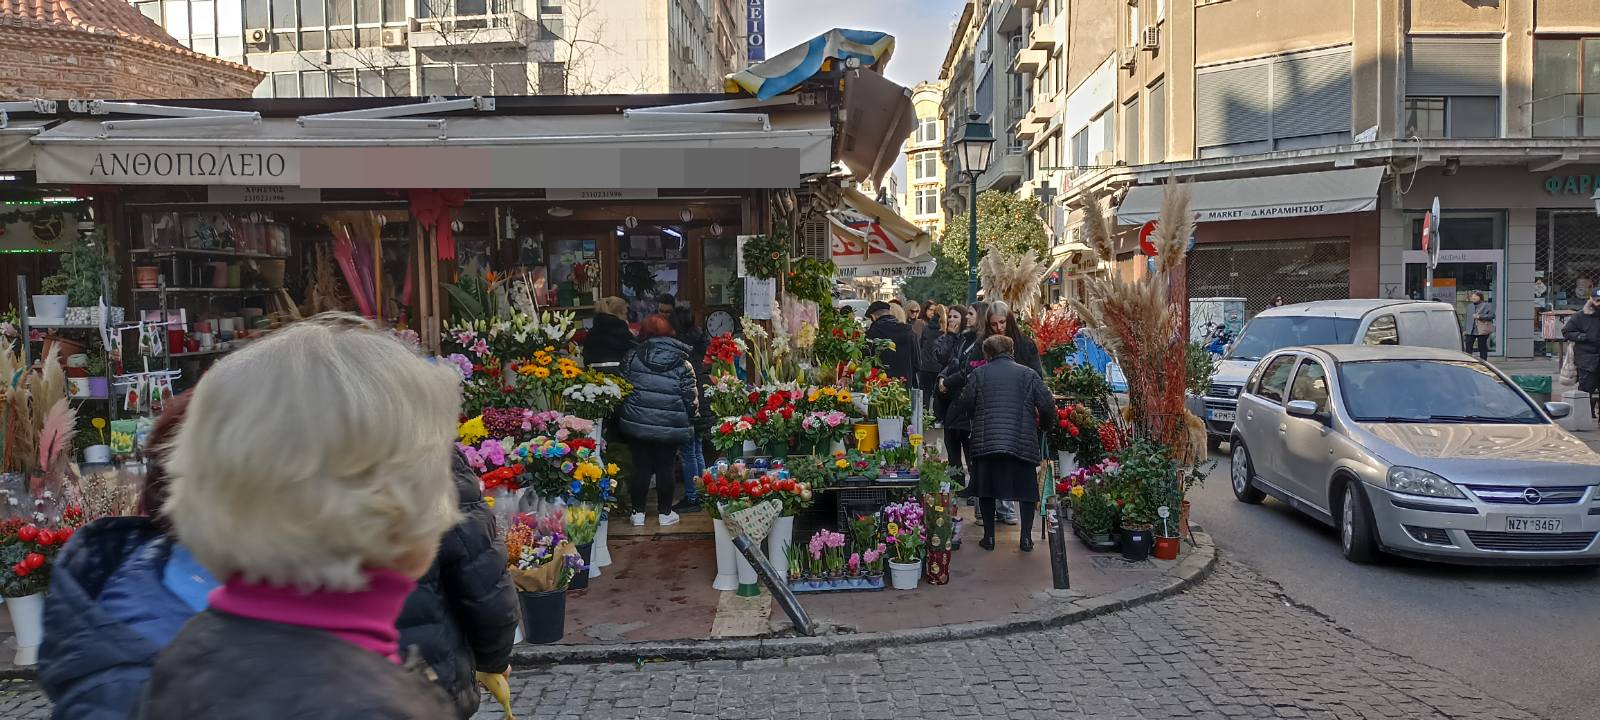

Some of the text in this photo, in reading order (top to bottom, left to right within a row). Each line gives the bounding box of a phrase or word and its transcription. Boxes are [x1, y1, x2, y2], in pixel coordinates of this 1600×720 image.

[90, 152, 286, 177] ΑΝΘΟΠΩΛΕΙΟ
[1208, 210, 1242, 219] MARKET
[1509, 519, 1529, 530] NZY
